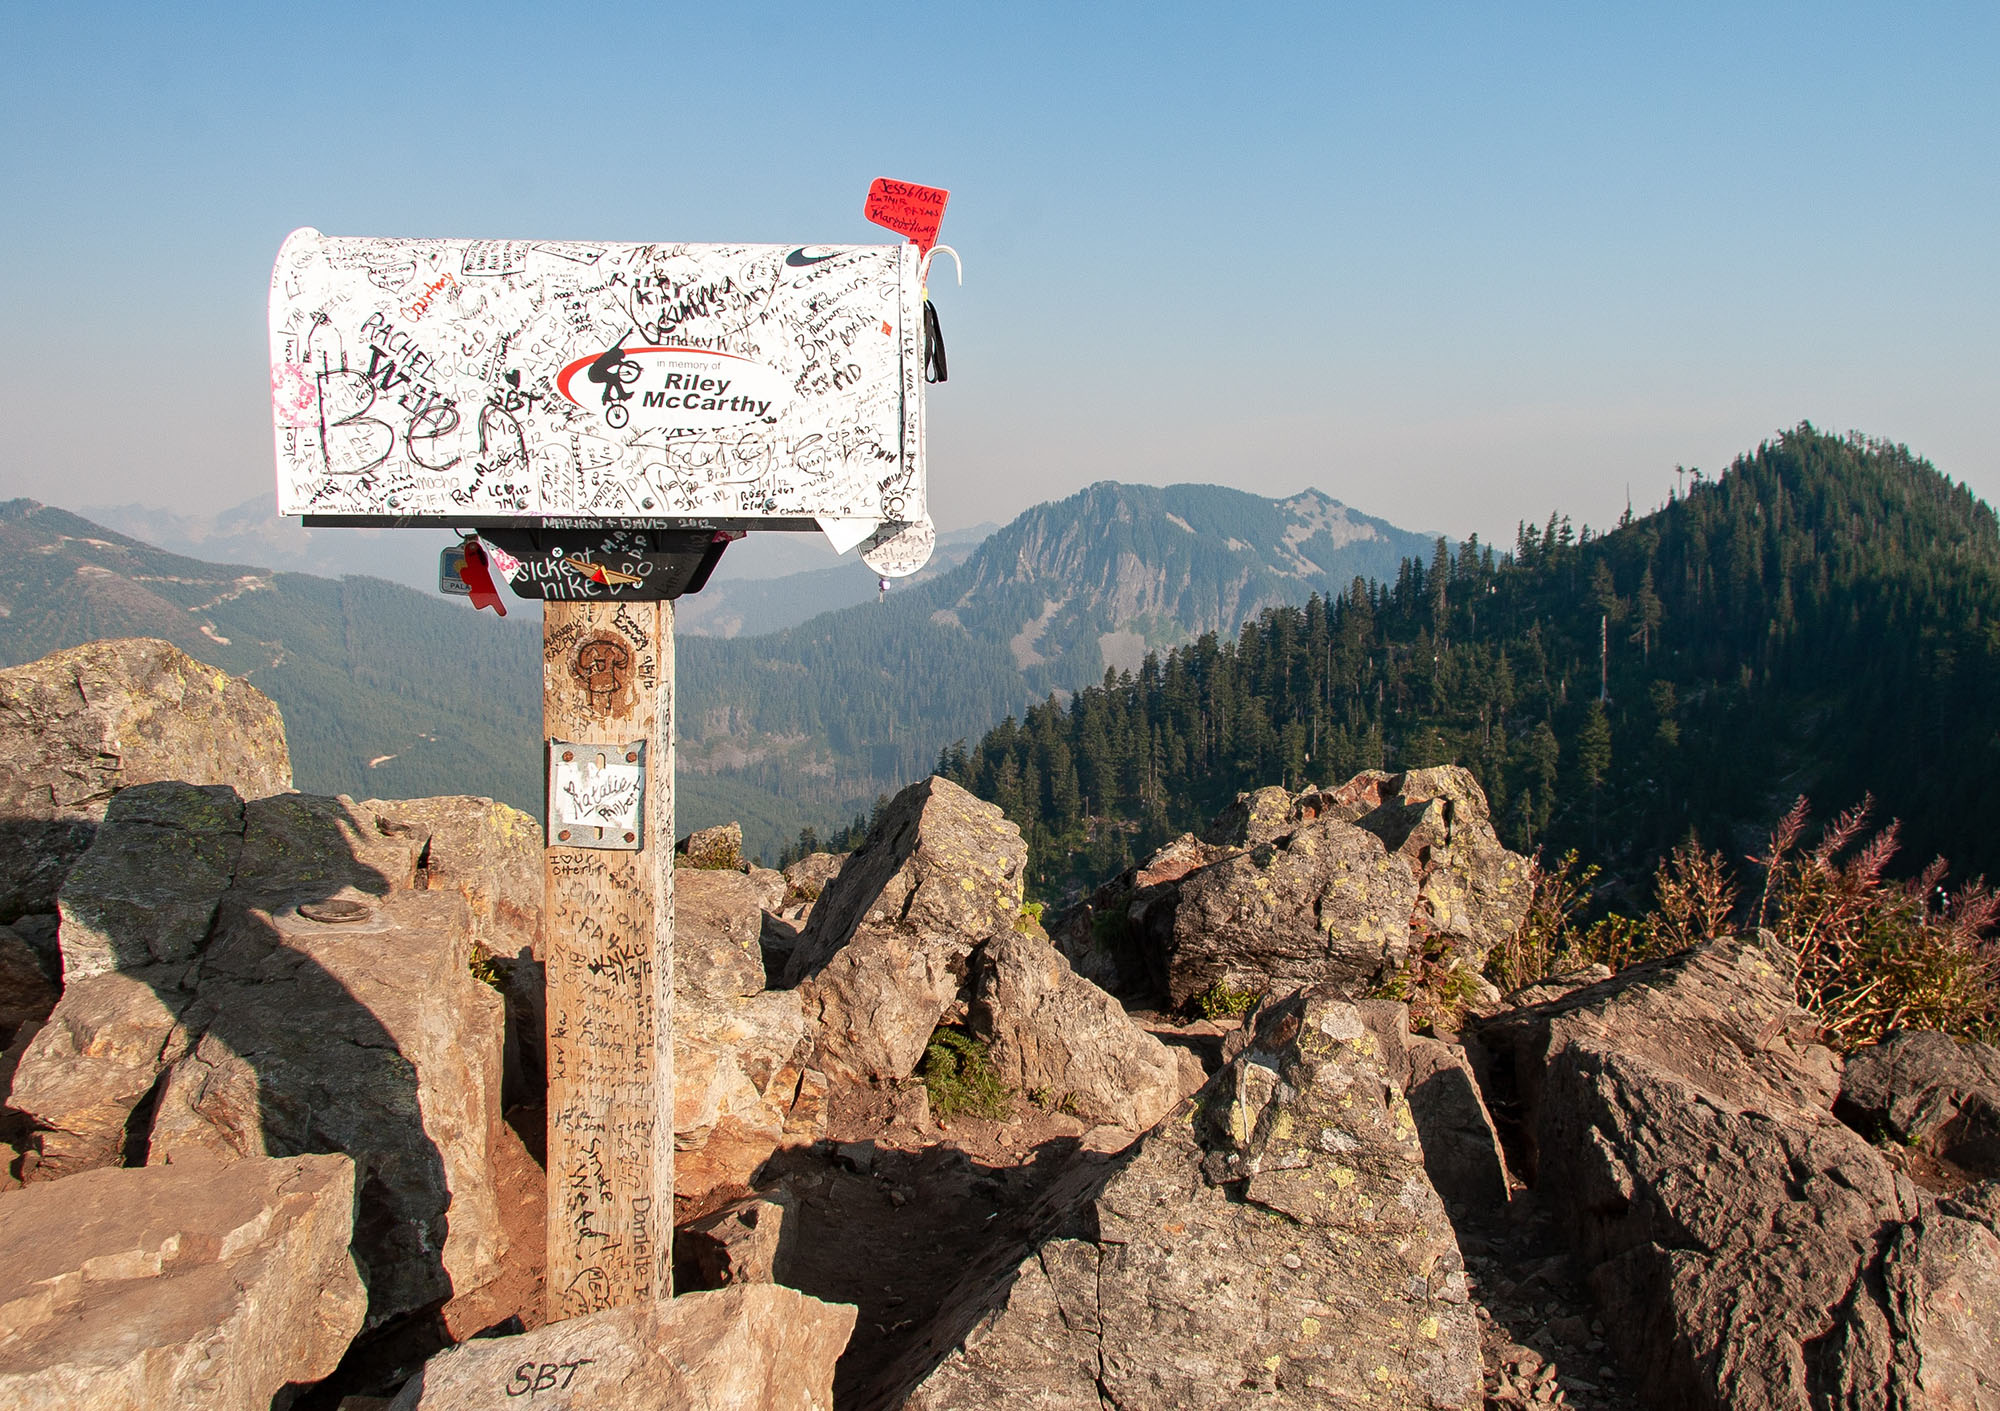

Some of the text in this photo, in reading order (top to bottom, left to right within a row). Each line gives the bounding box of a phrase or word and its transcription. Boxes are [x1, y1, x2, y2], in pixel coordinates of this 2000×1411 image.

[361, 311, 436, 385] RACHEL
[668, 360, 710, 371] memory
[711, 362, 721, 370] of
[664, 372, 732, 396] Riley
[642, 391, 772, 417] McCarthy
[619, 518, 669, 530] DAVIS
[632, 1195, 652, 1281] Danielle
[505, 1359, 596, 1399] SBT
